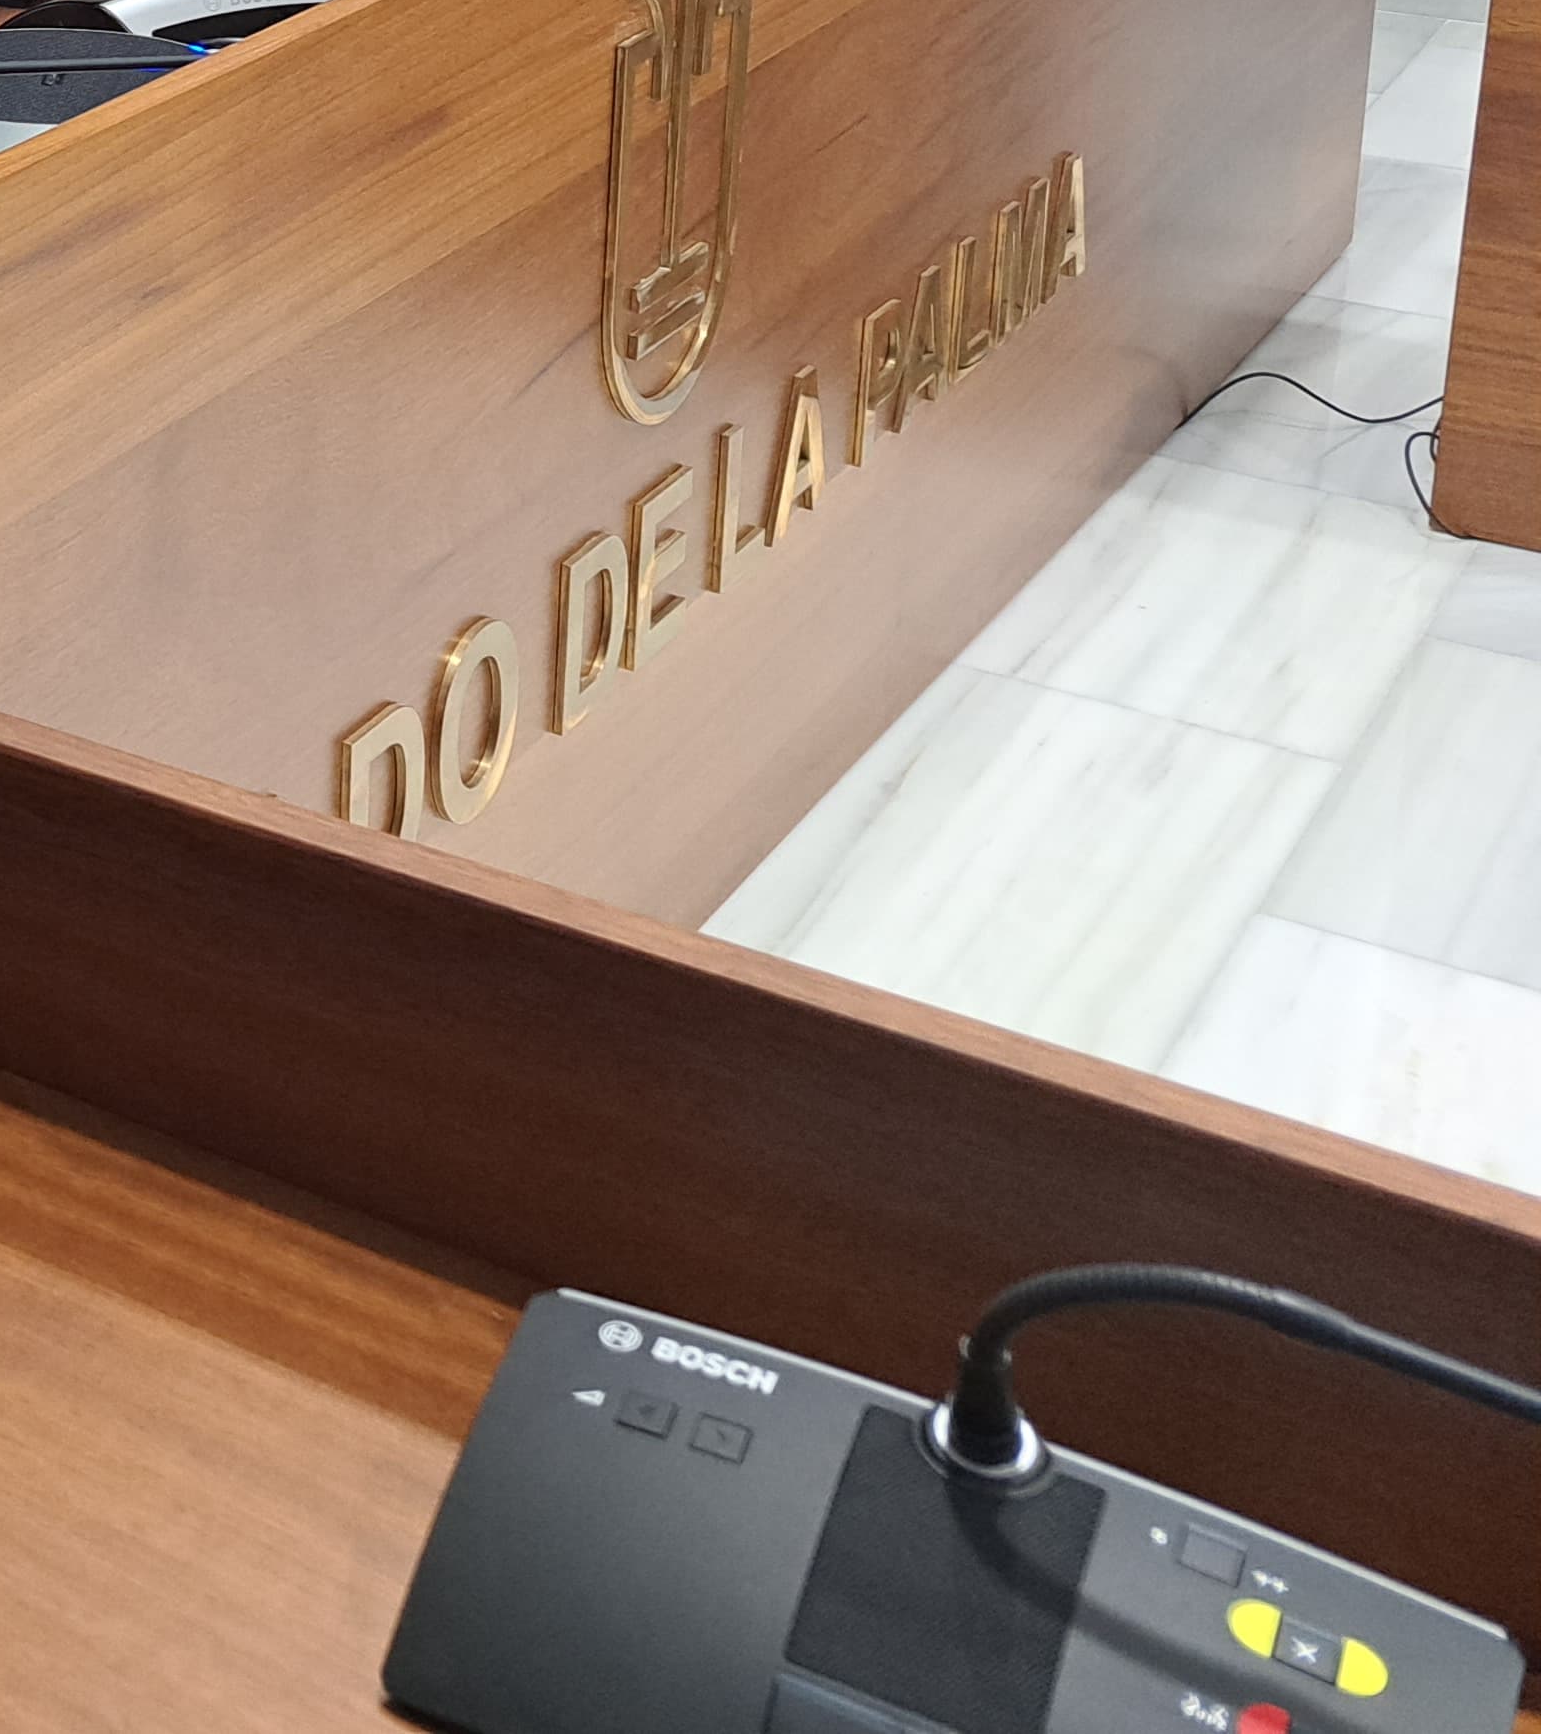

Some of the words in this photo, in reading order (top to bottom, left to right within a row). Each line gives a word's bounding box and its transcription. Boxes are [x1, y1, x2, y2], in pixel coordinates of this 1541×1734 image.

[552, 463, 693, 736] DE
[708, 364, 828, 595] LA
[851, 149, 1088, 468] PALMA
[650, 1335, 779, 1395] BOSCH
